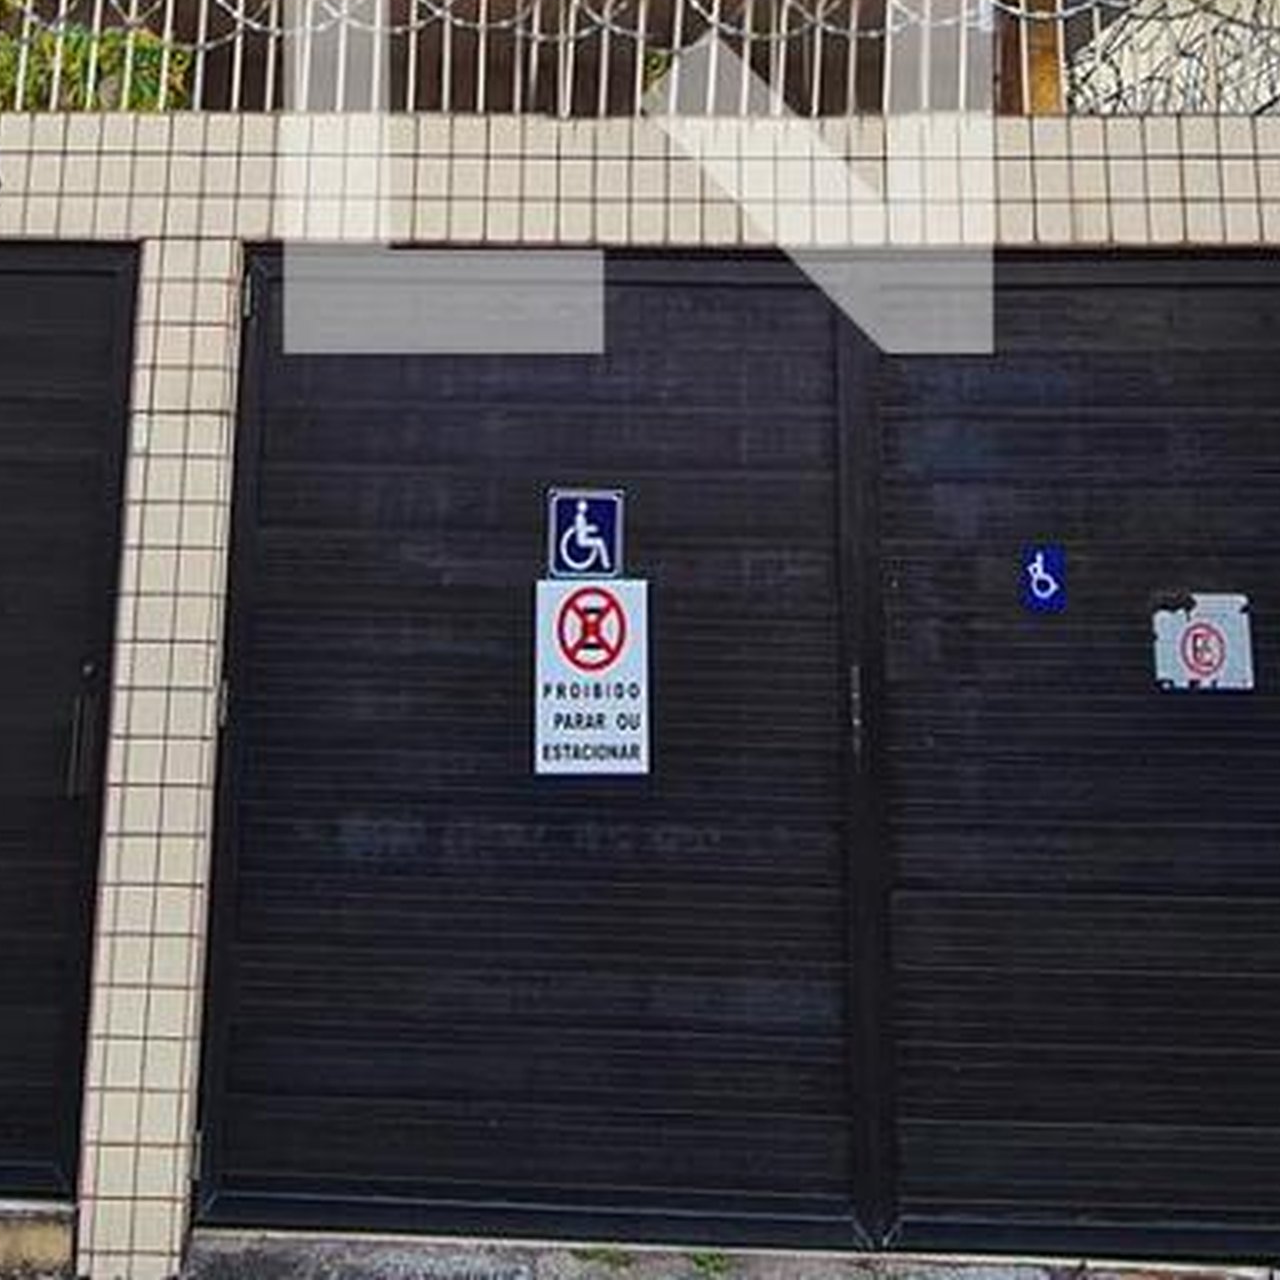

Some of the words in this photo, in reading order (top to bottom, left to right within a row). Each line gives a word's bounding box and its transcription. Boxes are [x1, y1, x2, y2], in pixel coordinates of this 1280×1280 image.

[543, 682, 640, 699] PROIBIDO
[553, 712, 605, 730] PARAR
[616, 712, 640, 730] OU
[542, 743, 640, 761] ESTACIONAR
